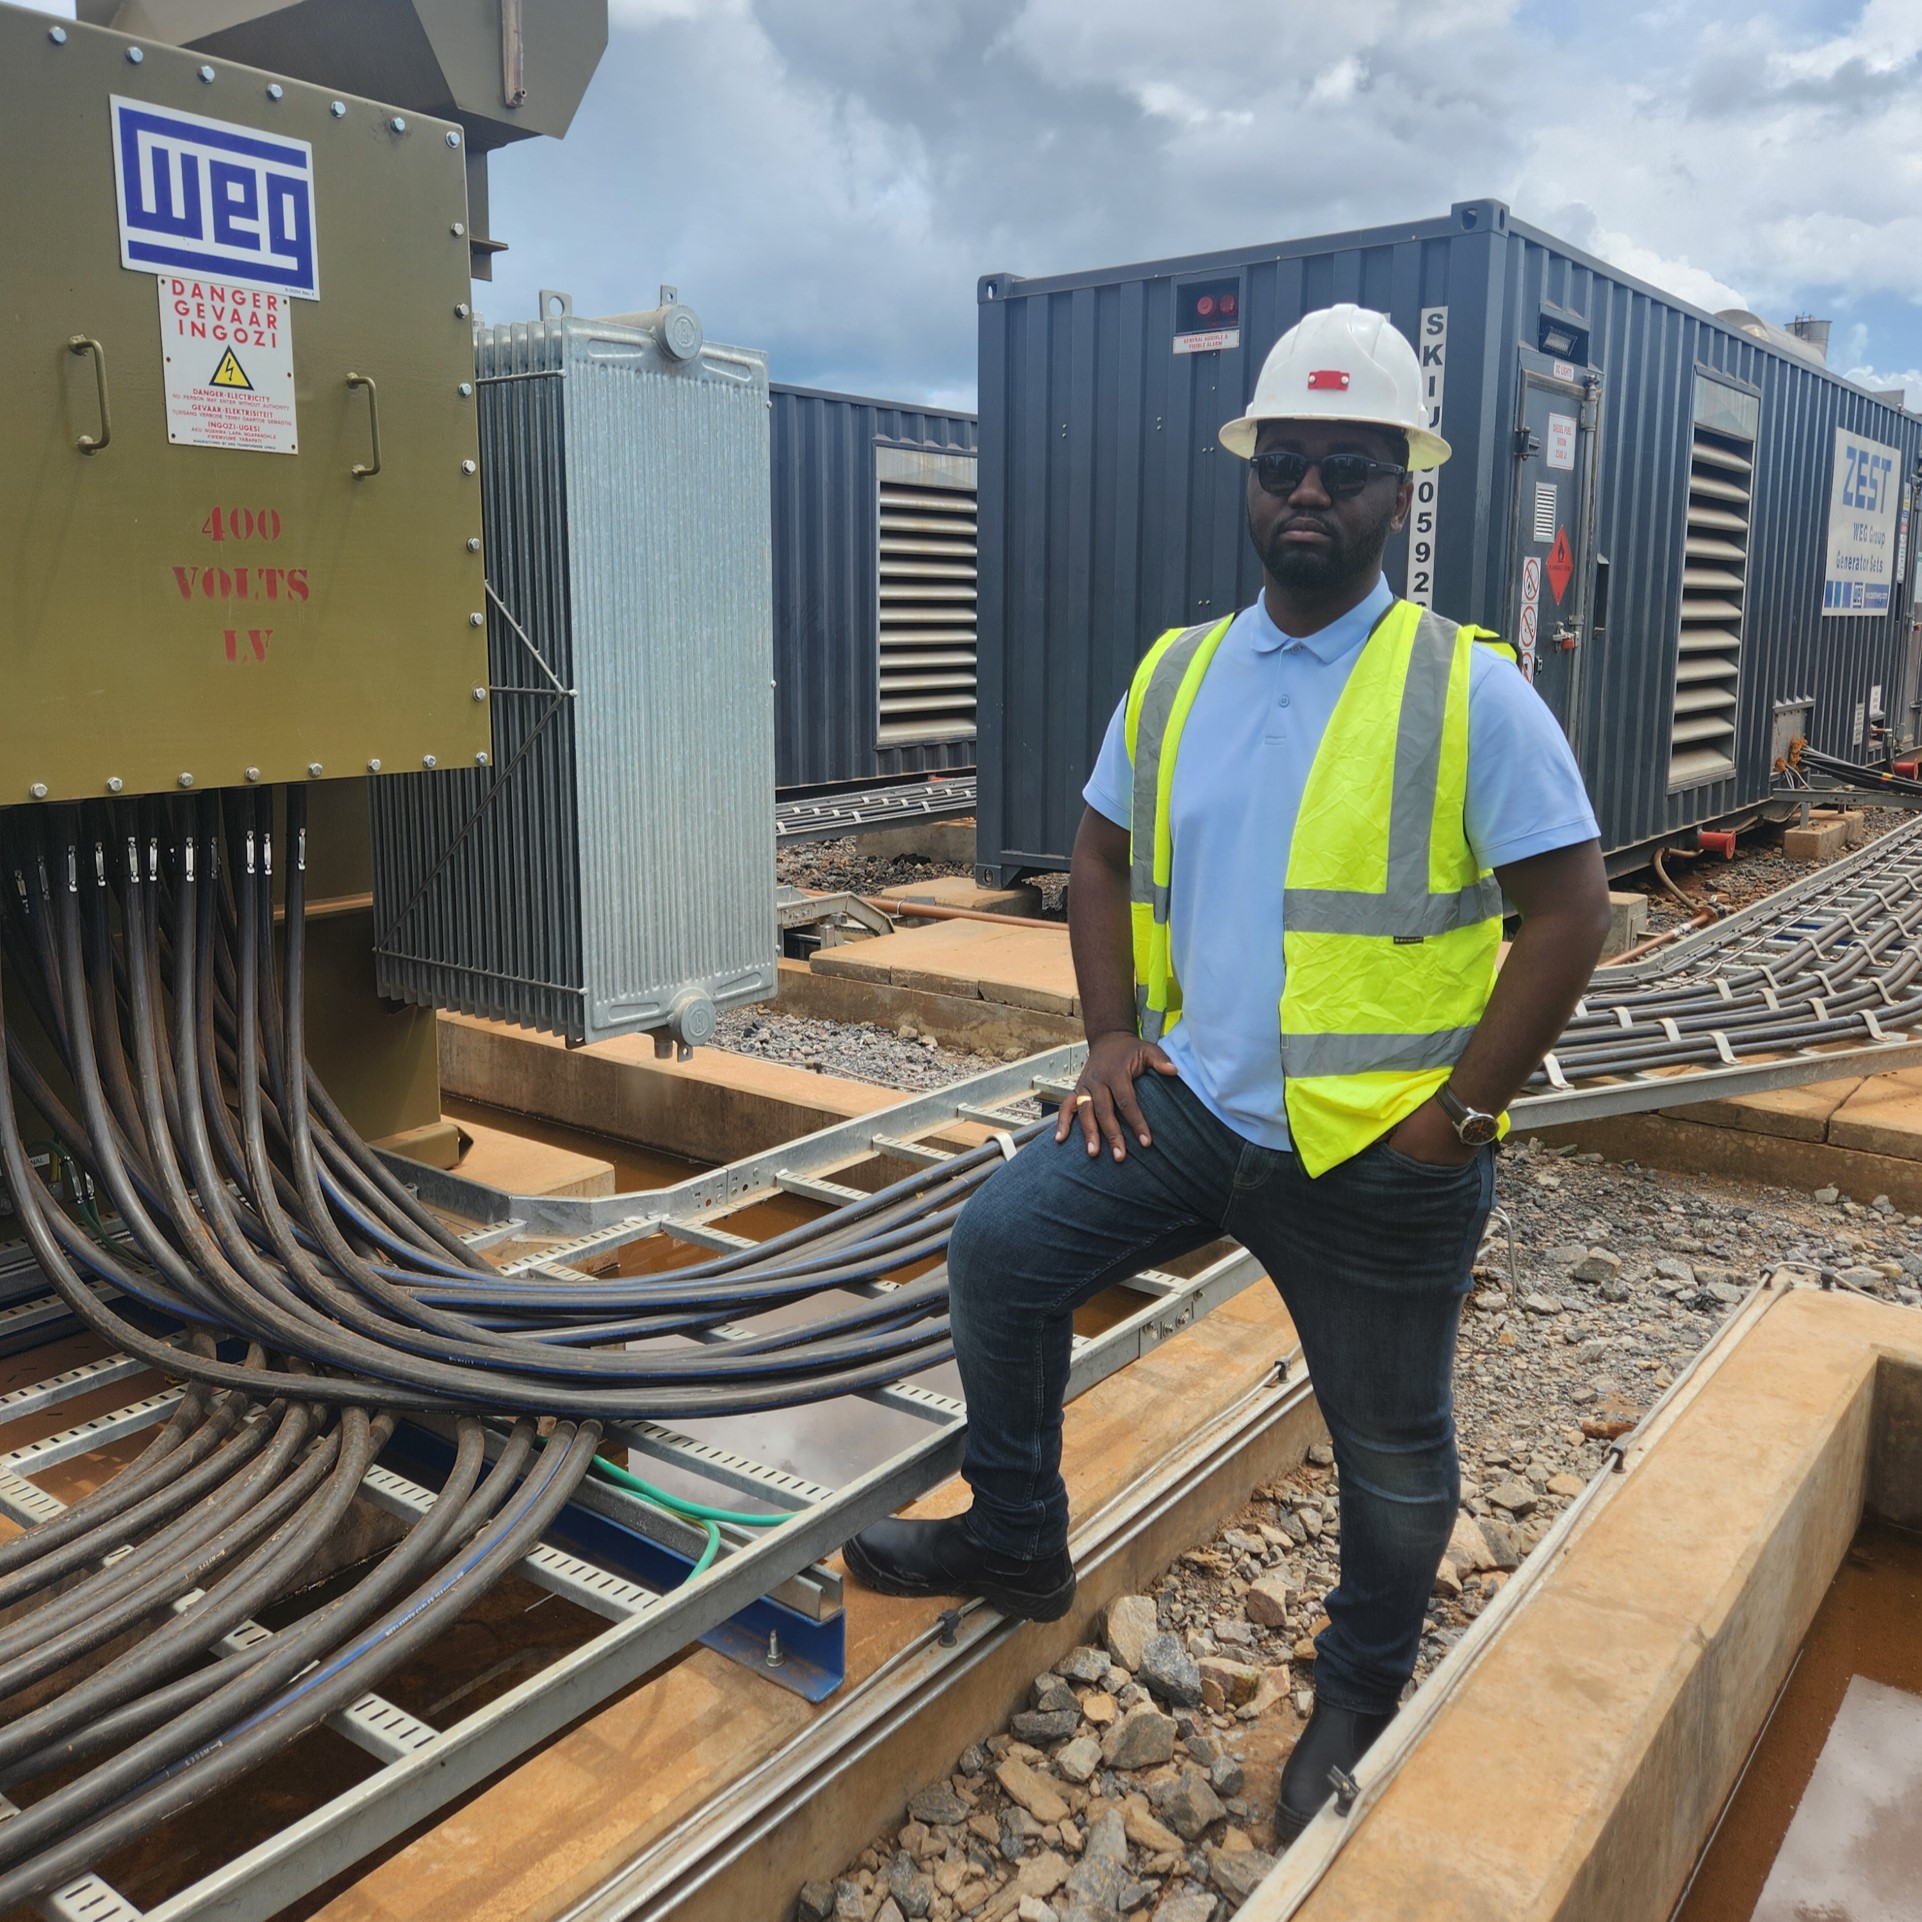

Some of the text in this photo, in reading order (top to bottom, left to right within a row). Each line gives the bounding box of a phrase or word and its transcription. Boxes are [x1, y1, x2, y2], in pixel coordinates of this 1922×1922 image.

[171, 279, 278, 312] DANGER
[174, 300, 278, 330] GEVAAR
[178, 319, 276, 348] INGOZI
[1842, 446, 1892, 514] ZEST
[202, 506, 280, 542] 400
[1413, 466, 1435, 610] 0592
[1853, 522, 1886, 549] WEG Group
[1836, 550, 1869, 572] Generator
[1870, 557, 1883, 573] Sets
[172, 566, 310, 601] VOLTS
[223, 630, 274, 663] LV
